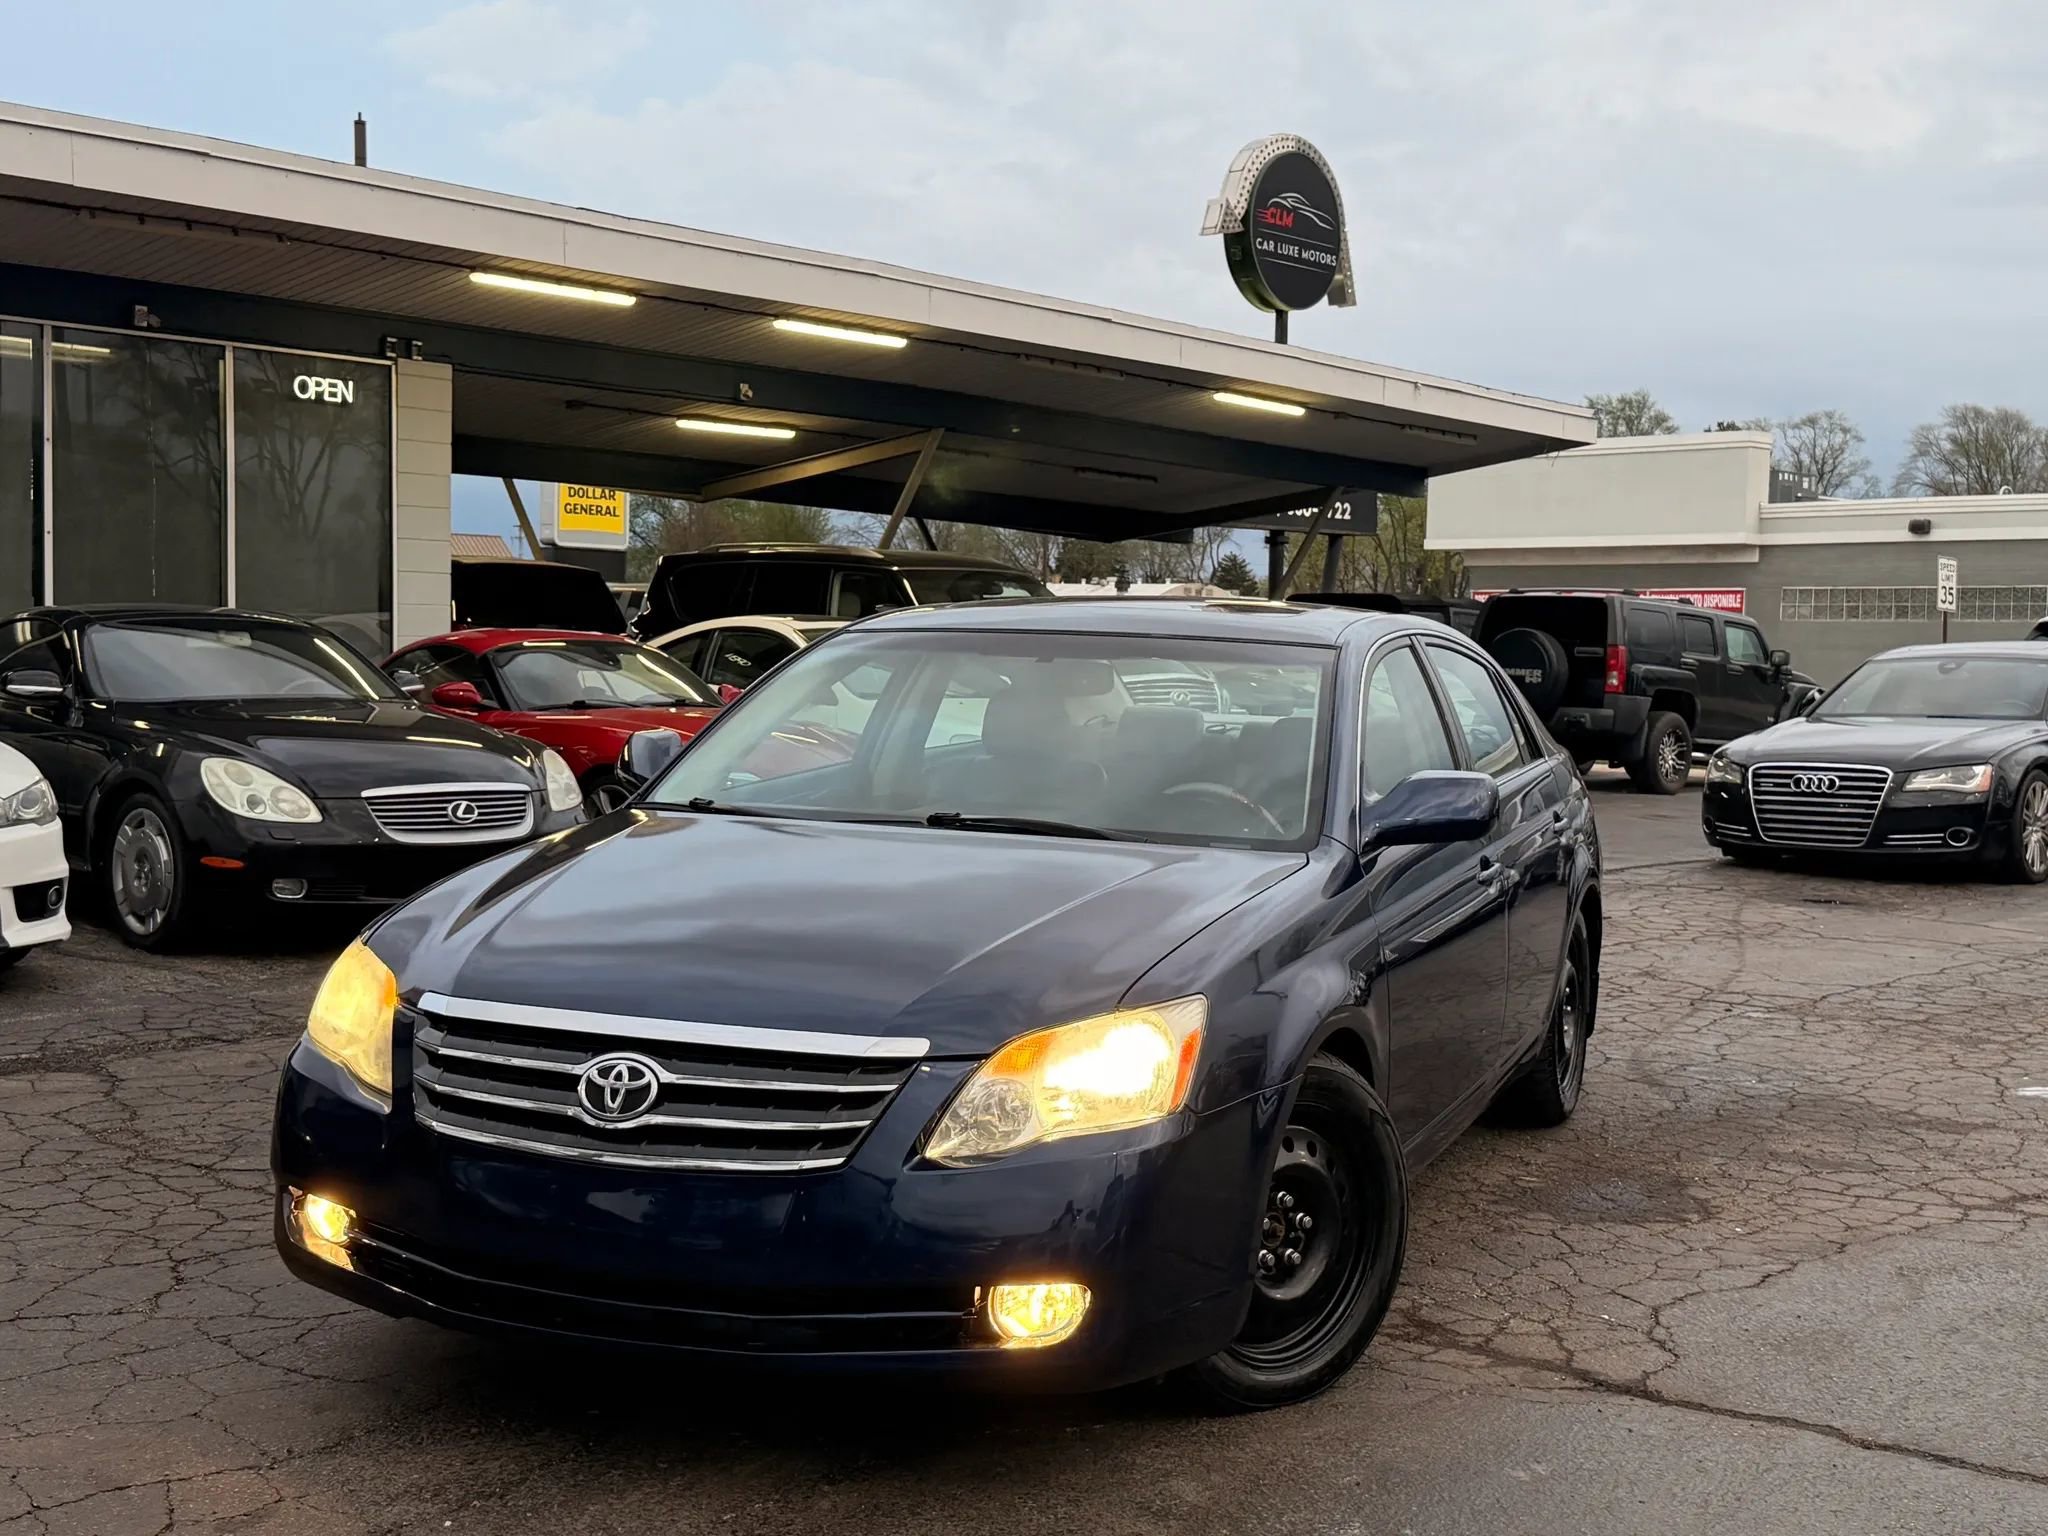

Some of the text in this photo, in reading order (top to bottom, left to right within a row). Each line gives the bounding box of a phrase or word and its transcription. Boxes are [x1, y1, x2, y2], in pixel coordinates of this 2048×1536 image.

[1267, 207, 1294, 228] CLM
[1256, 238, 1337, 267] CAR LUXE MOTORS
[293, 375, 354, 404] OPEN
[568, 486, 616, 501] DOLLAR
[564, 502, 620, 517] GENERAL
[1940, 562, 1955, 573] SPEED
[1941, 573, 1954, 583] LIMIT
[1704, 594, 1741, 608] DISPONIBLE
[1940, 586, 1954, 605] 35
